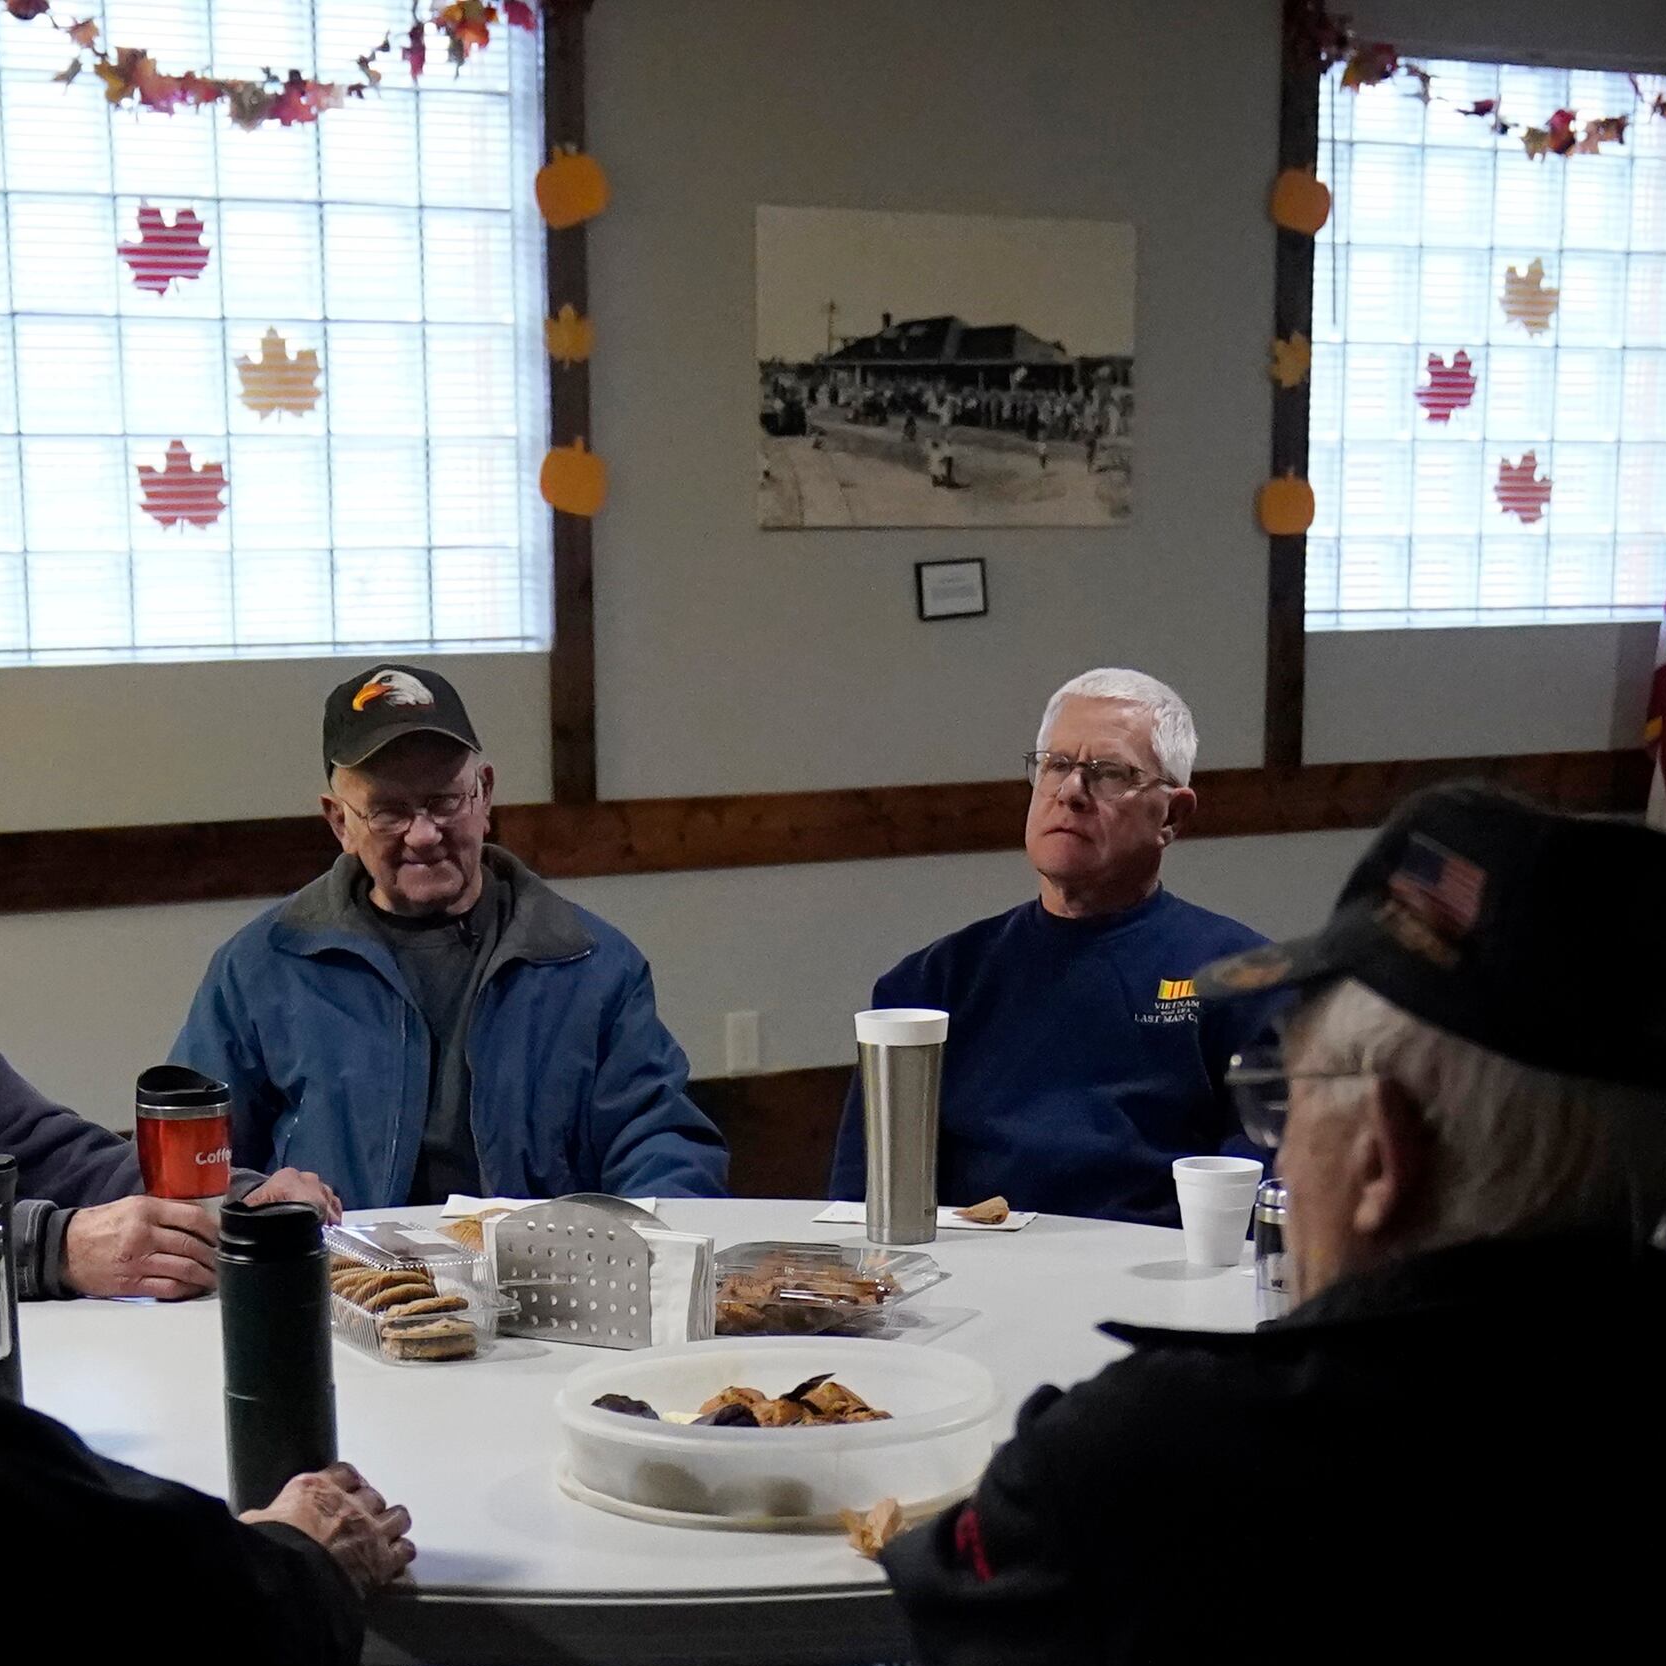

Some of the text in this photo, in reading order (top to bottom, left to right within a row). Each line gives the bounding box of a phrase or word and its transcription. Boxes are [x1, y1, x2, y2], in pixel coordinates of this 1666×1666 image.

[1154, 1000, 1200, 1010] VIETNAM
[1134, 1012, 1161, 1024] LAST
[1162, 1013, 1185, 1023] MAN
